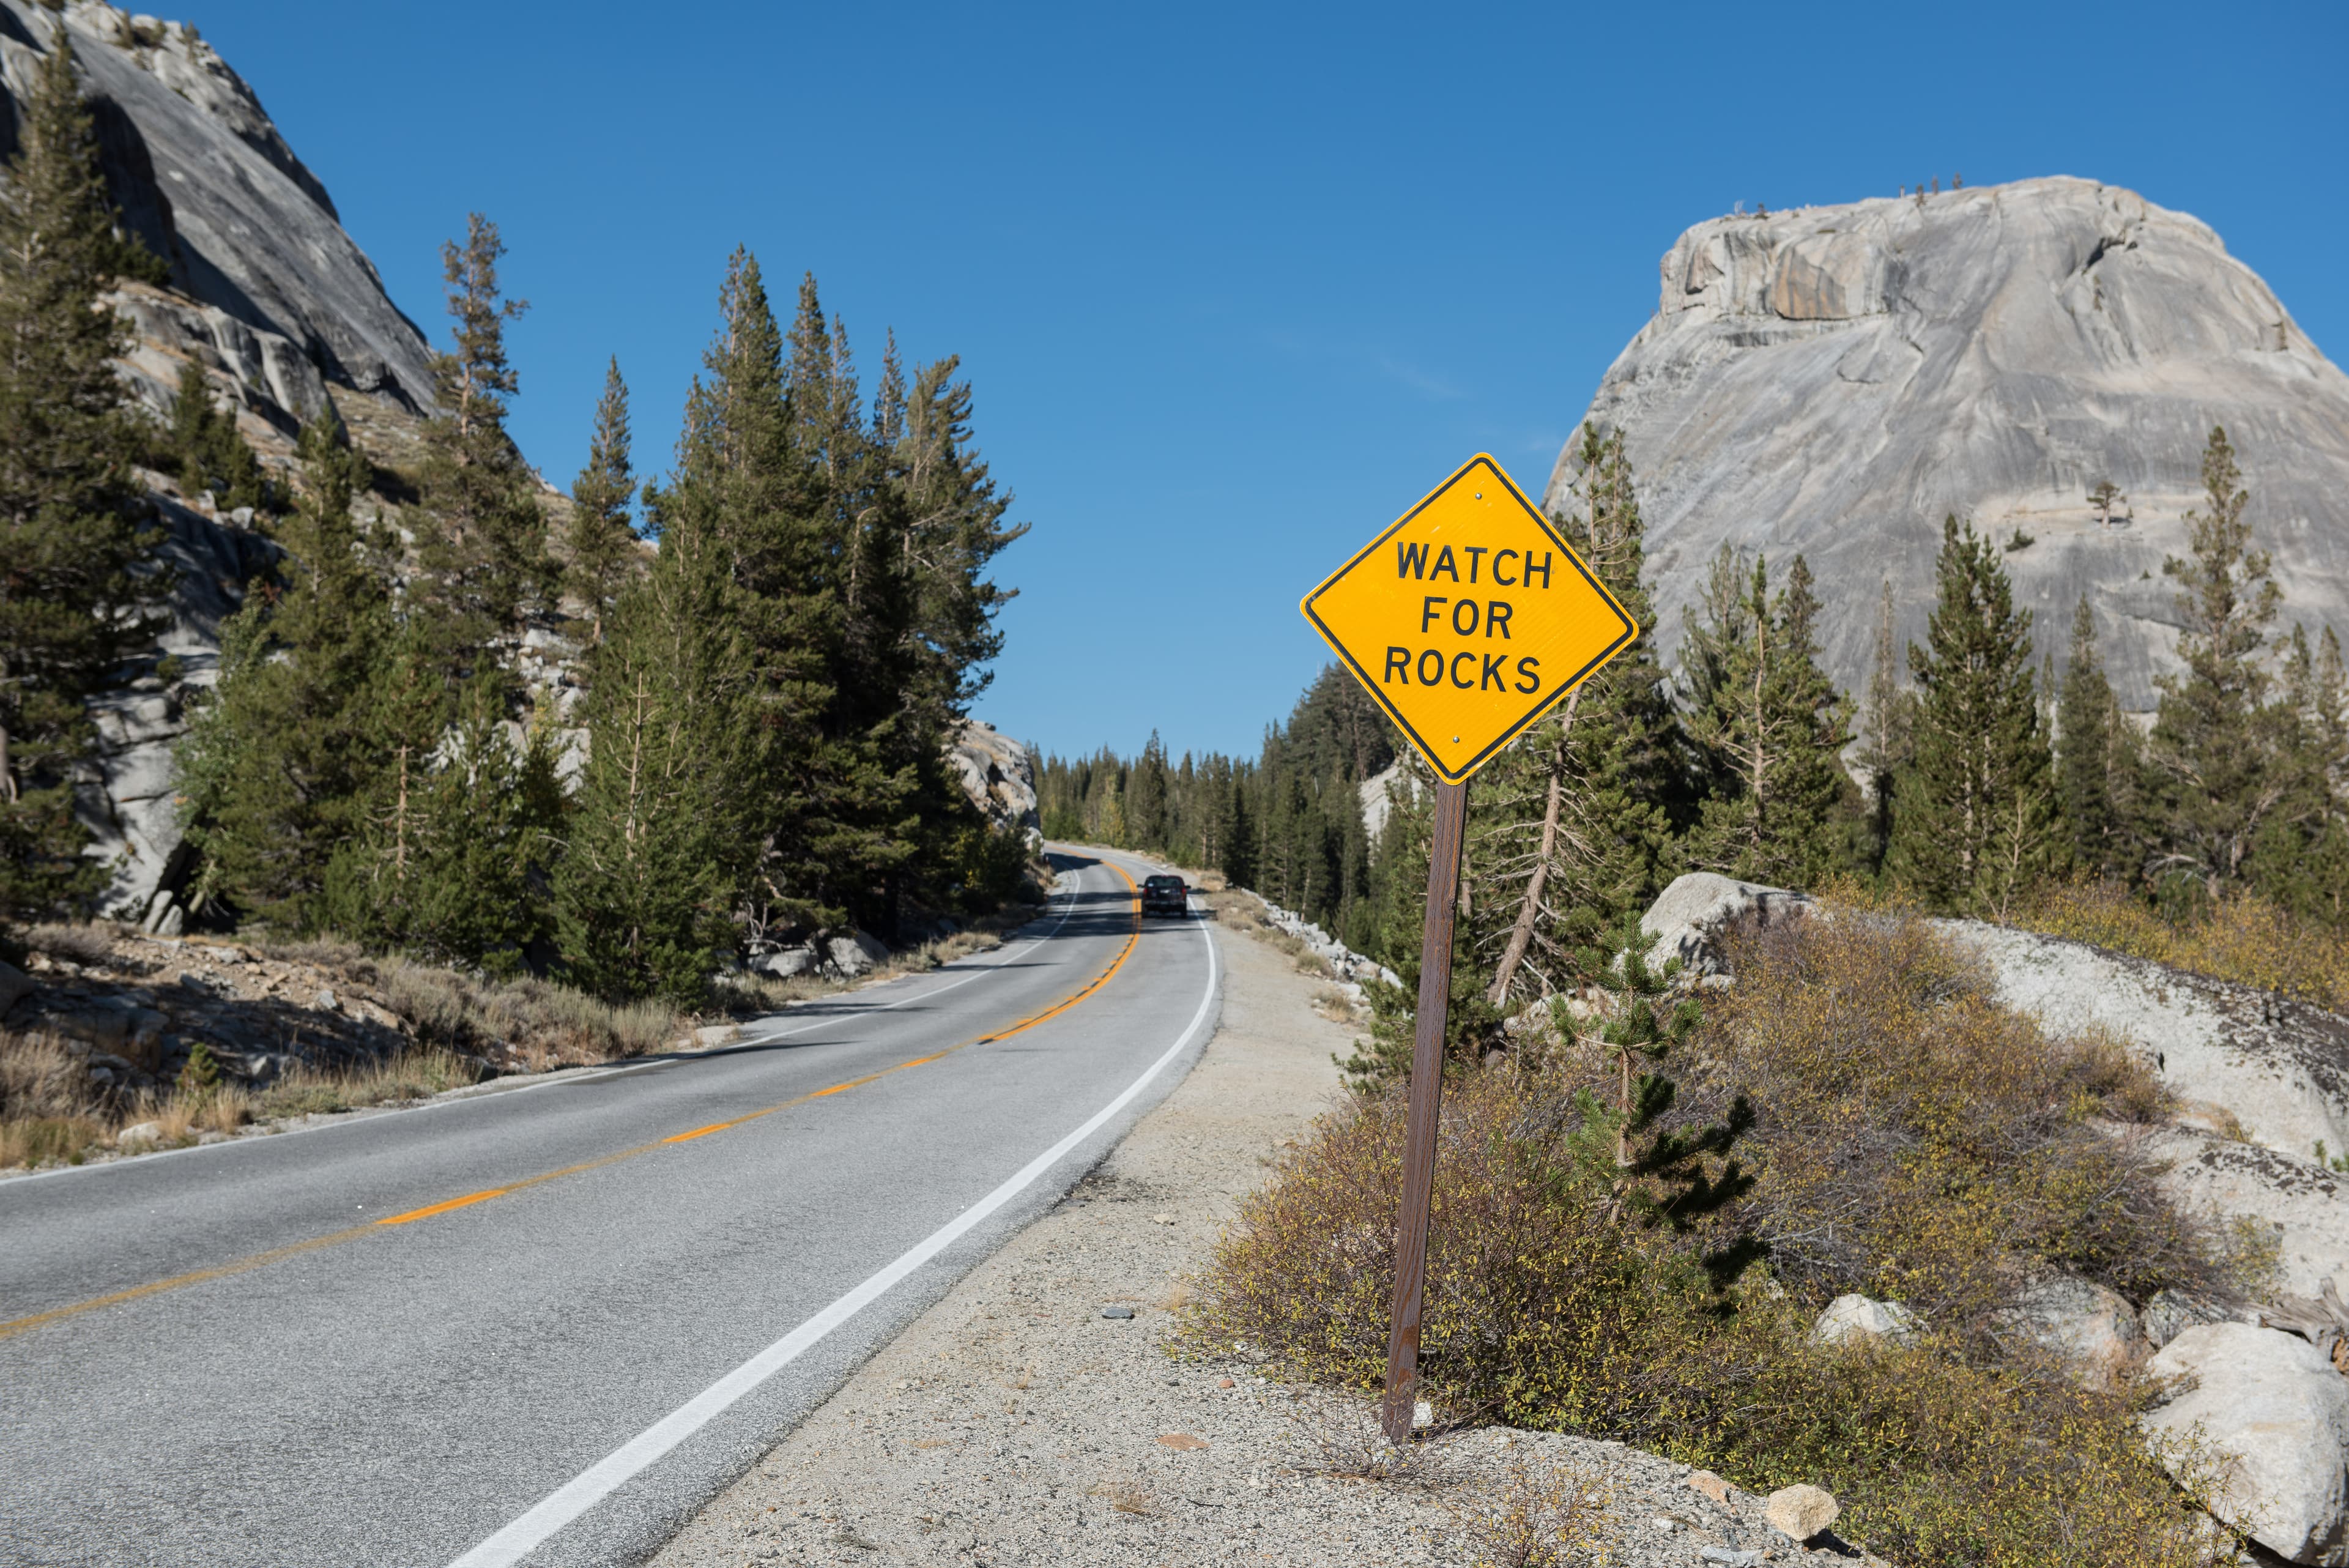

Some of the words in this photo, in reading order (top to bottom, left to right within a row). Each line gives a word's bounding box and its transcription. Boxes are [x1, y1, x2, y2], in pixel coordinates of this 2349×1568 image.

[1397, 541, 1552, 589] WATCH
[1421, 596, 1513, 639] FOR
[1384, 645, 1540, 694] ROCKS
